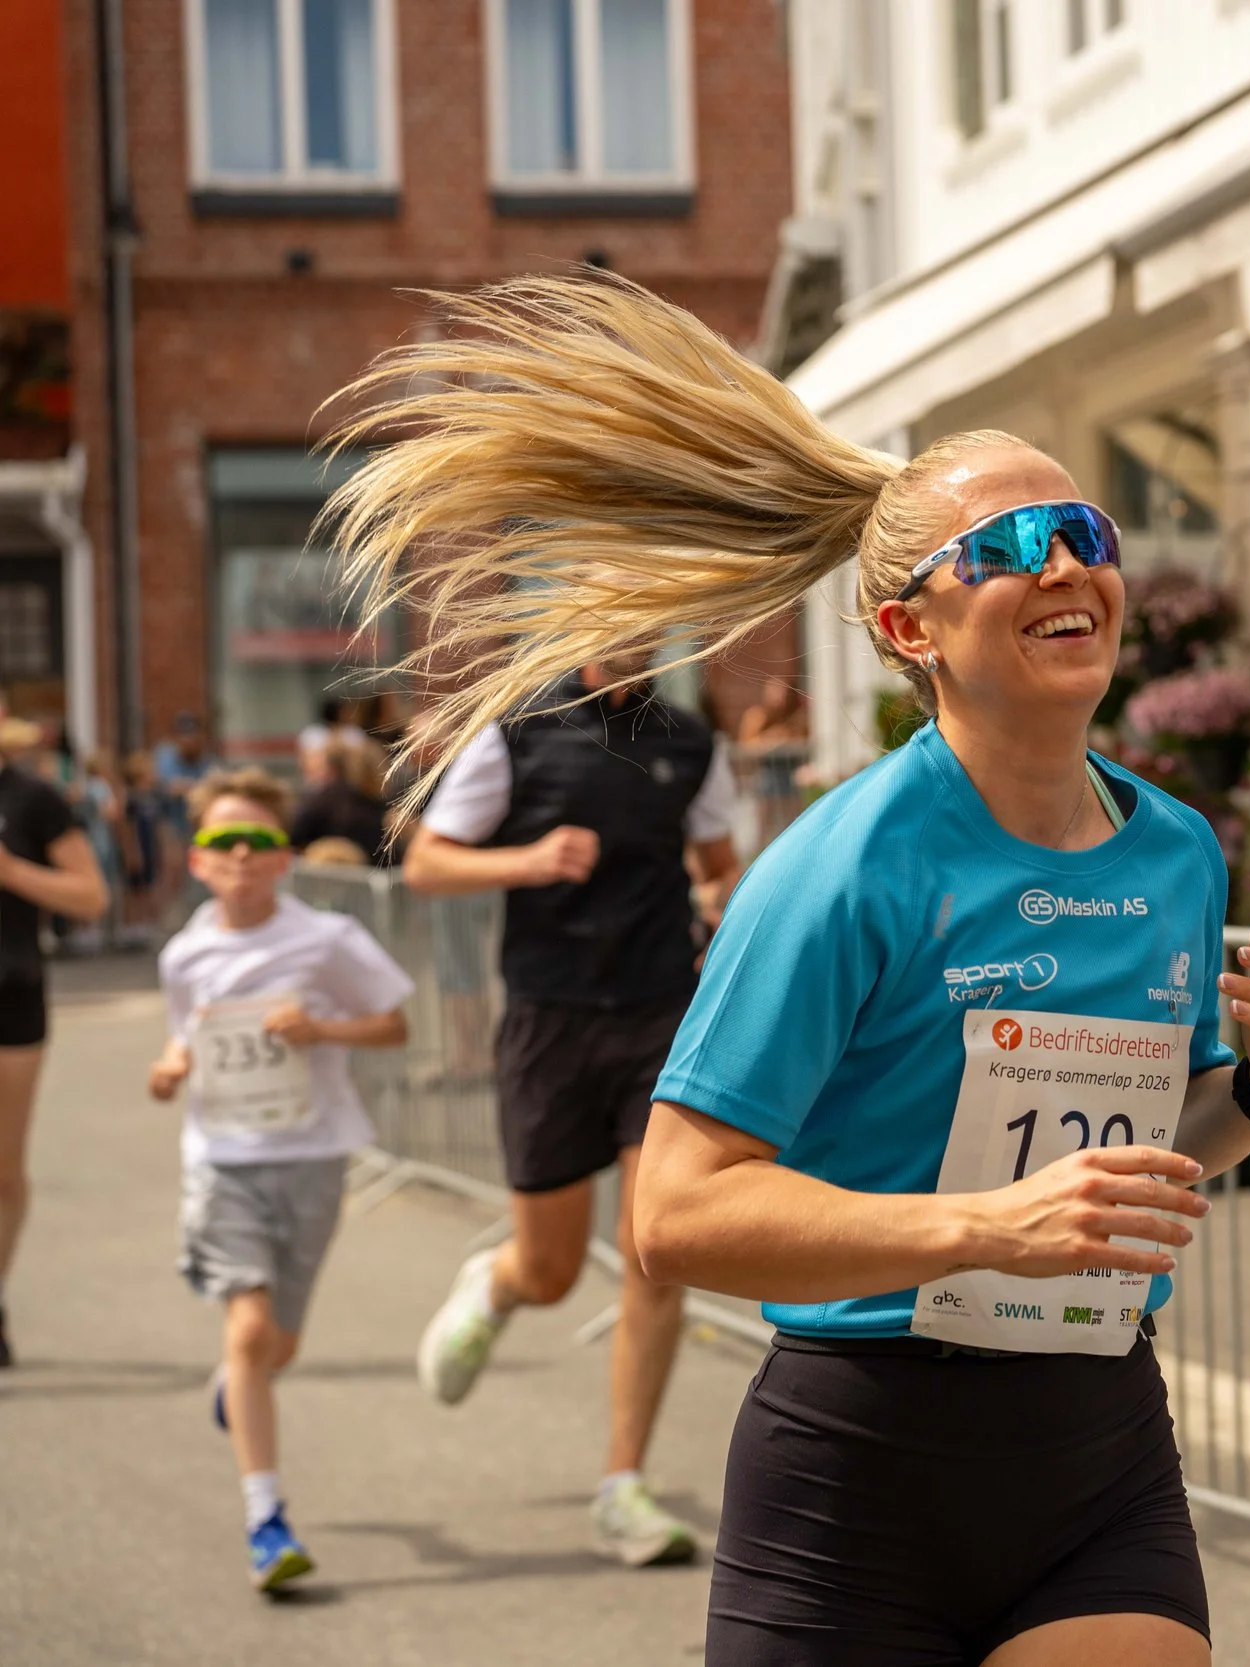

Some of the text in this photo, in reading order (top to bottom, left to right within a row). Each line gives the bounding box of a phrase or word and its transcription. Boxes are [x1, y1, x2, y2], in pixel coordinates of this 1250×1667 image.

[1023, 897, 1149, 917] GS Maskin AS
[943, 961, 1025, 986] sport
[213, 1033, 286, 1073] 235
[1029, 1026, 1171, 1060] Bedriftsidretten
[988, 1061, 1171, 1091] Kragerø sommerløp 2026
[1151, 1127, 1166, 1140] 5
[994, 1302, 1045, 1320] SWML
[1063, 1306, 1093, 1325] KIWI
